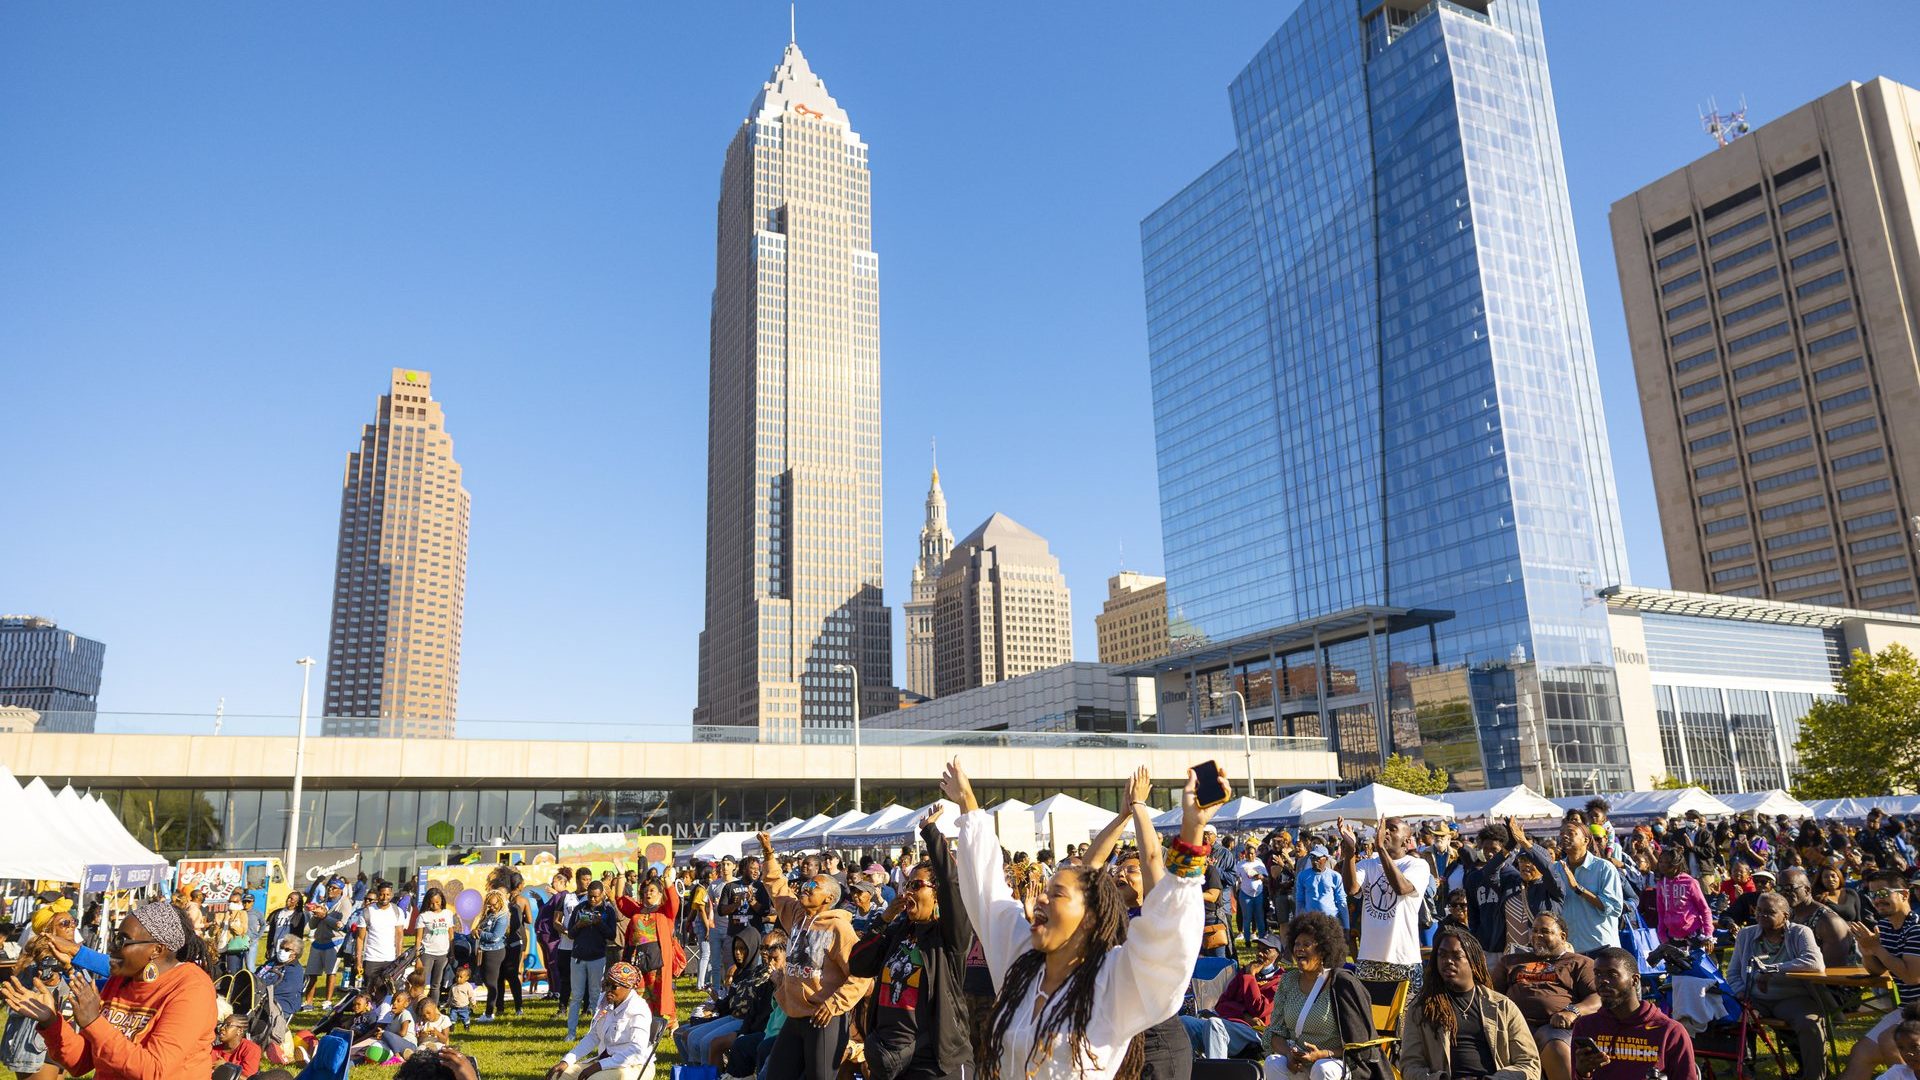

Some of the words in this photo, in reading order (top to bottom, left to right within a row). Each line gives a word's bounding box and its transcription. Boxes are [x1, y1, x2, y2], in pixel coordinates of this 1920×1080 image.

[1613, 646, 1646, 664] ilton
[1162, 690, 1187, 704] ilton
[461, 824, 630, 844] HUNTINGTON
[645, 822, 784, 838] CONVENTIO
[1477, 886, 1500, 906] GA
[1597, 1035, 1625, 1043] CENTAL
[1627, 1036, 1648, 1045] STATE
